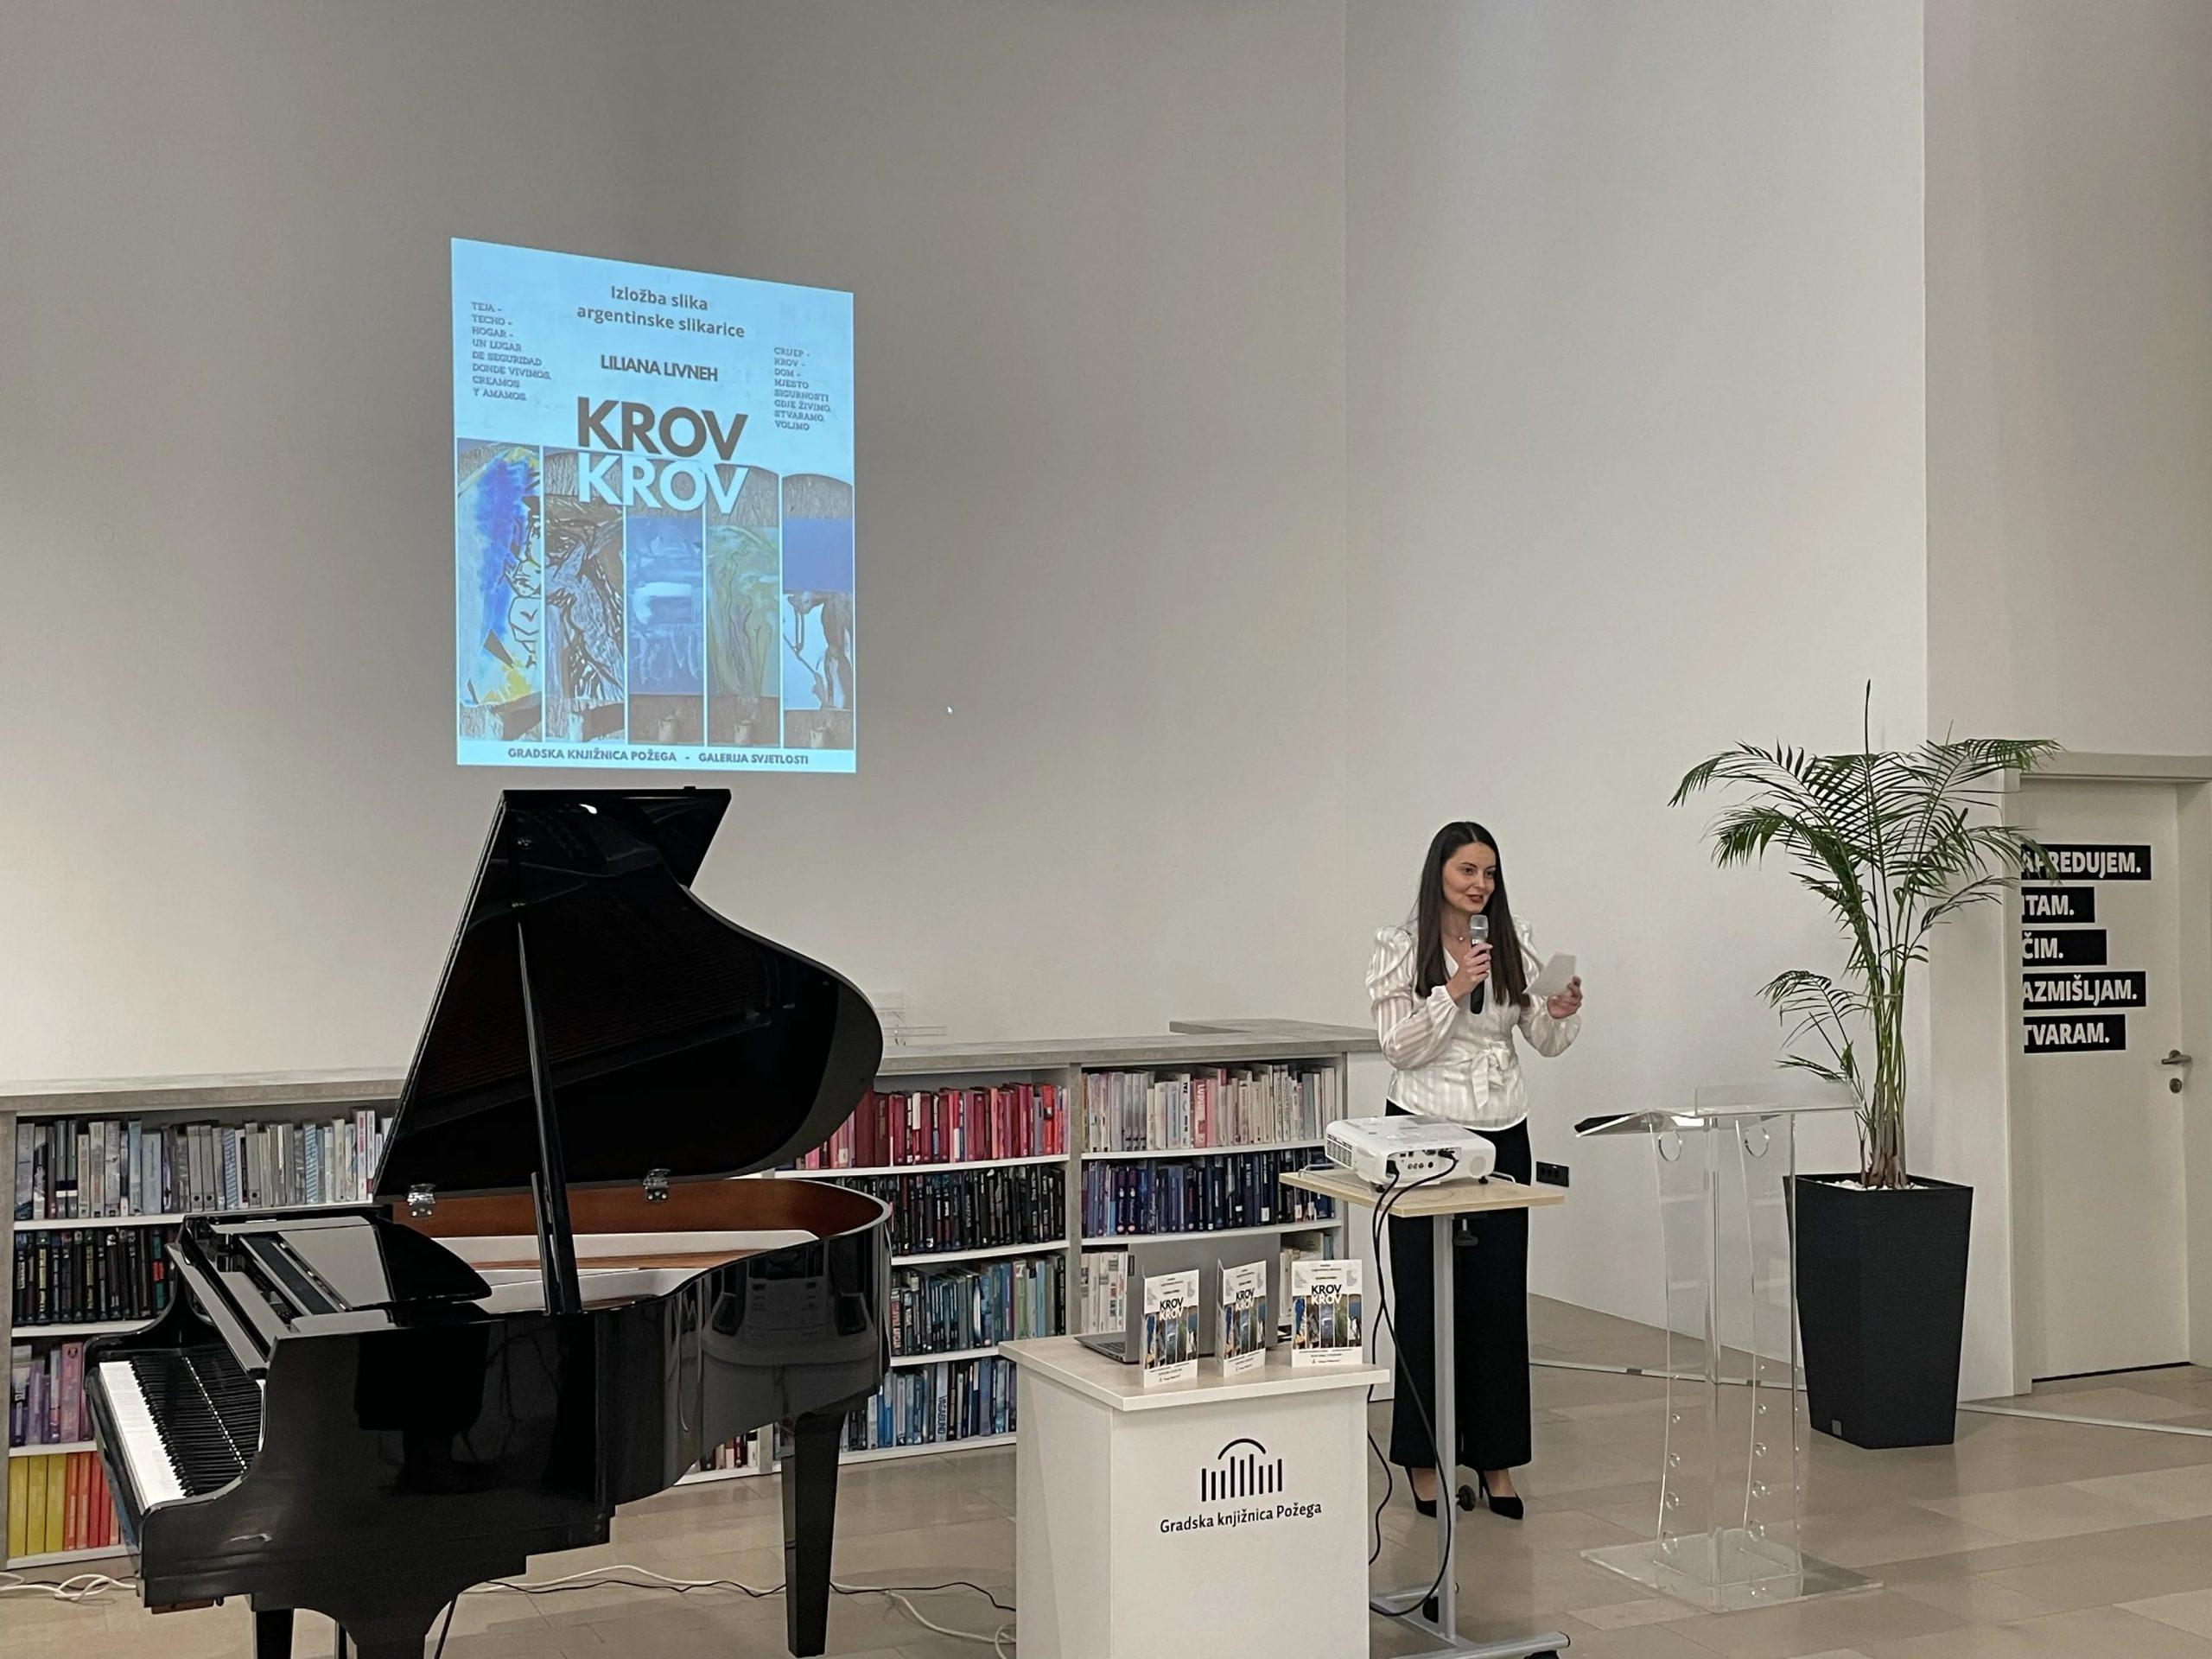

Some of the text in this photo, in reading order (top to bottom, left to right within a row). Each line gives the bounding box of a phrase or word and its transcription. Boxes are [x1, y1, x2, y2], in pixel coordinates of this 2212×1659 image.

[611, 285, 708, 311] Izložba slika
[471, 302, 495, 312] TEJA
[471, 314, 505, 326] TECHO
[577, 307, 745, 338] argentinske slikarice
[472, 327, 506, 338] HOGAR
[472, 339, 522, 352] UN LUGAR
[472, 351, 542, 365] DE SEGURIDAD
[774, 357, 798, 367] KROV
[473, 363, 506, 375] DONDE
[601, 354, 718, 382] LILIANA LIVNEH
[774, 368, 794, 378] DOM
[774, 378, 809, 389] MJESTO
[473, 387, 480, 397] Y
[774, 389, 830, 402] SIGURNOSTI
[774, 399, 796, 409] GDJE
[577, 396, 749, 461] KROV
[774, 420, 810, 430] VOLIMO
[578, 452, 750, 515] KROV
[508, 747, 564, 759] GRADSKA
[567, 747, 628, 760] KNJIŽNICA
[631, 749, 677, 762] POŽEGA
[698, 753, 748, 763] GALERIJA
[751, 754, 808, 765] SVJETLOSTI
[2022, 931, 2064, 959] ČIM.
[2023, 974, 2137, 1007] AZMIŠLJAM.
[1236, 1287, 1255, 1300] KROV
[1311, 1284, 1342, 1294] KROV
[1160, 1297, 1184, 1310] KROV
[1311, 1294, 1342, 1305] KROV
[1160, 1307, 1184, 1320] KROV
[1160, 1502, 1322, 1533] Gradska knjižnica Požega
